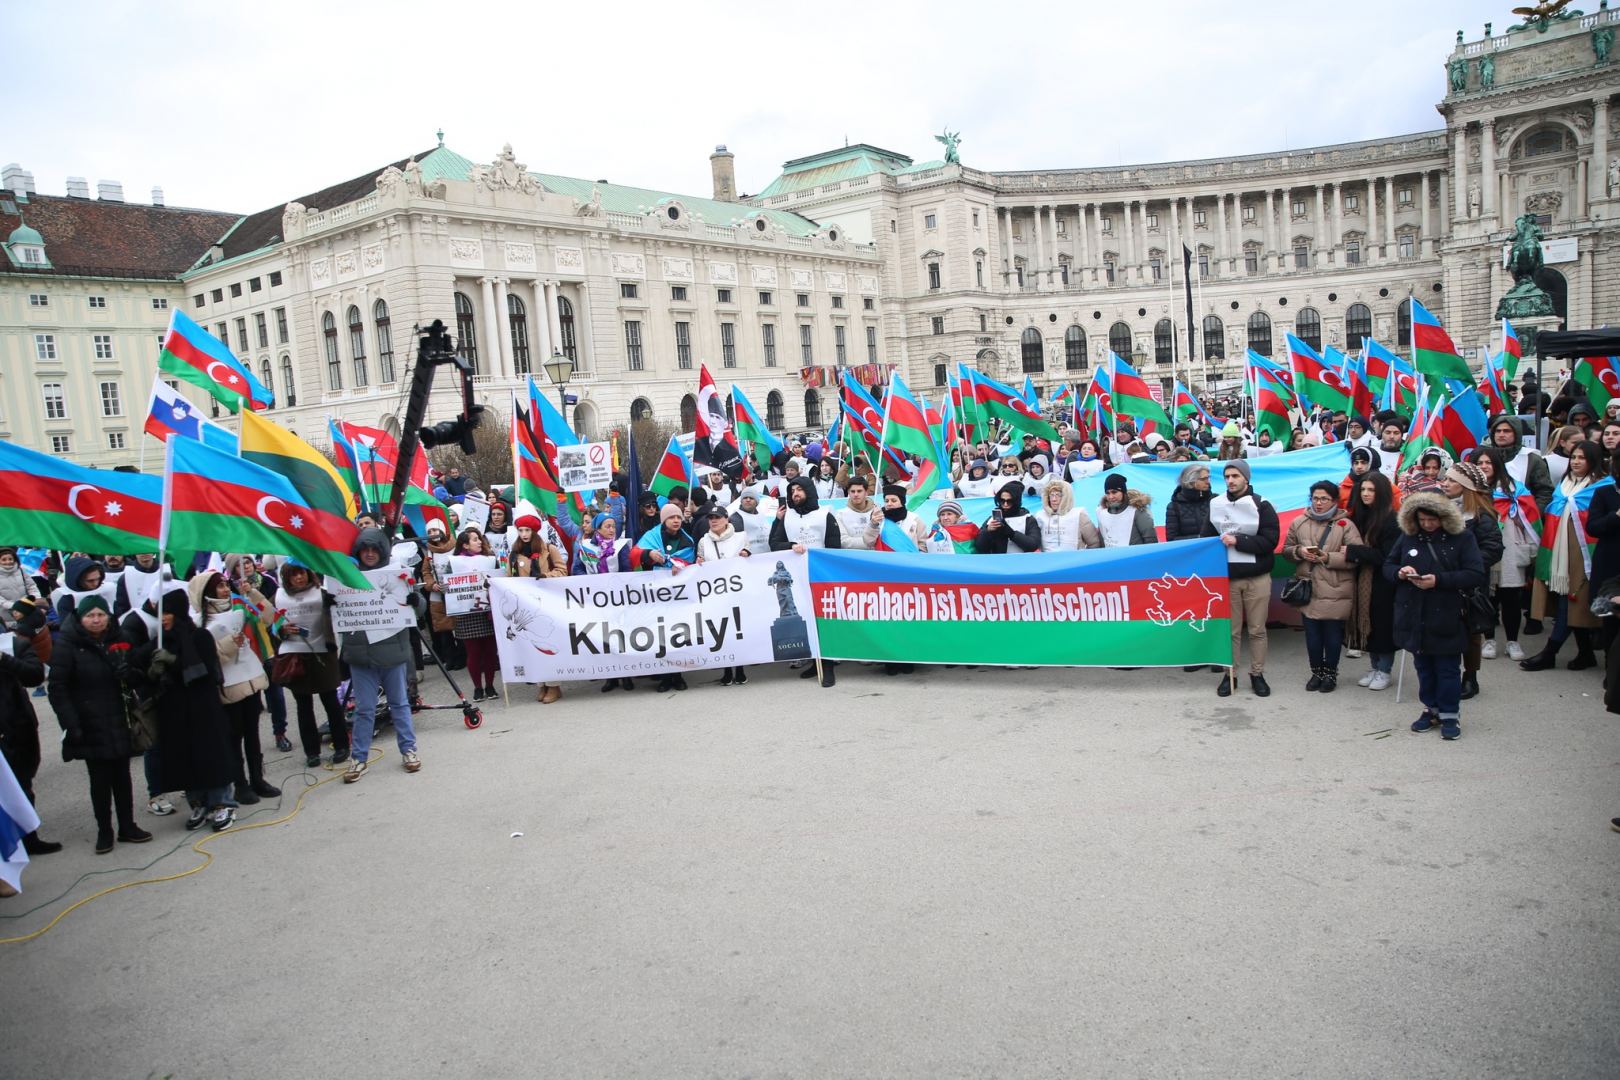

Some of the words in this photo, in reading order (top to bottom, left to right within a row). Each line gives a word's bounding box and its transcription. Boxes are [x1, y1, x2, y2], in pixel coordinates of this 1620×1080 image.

[447, 576, 468, 585] STOPPT
[469, 574, 479, 583] DIE
[565, 583, 689, 610] N'oubliez
[696, 574, 744, 600] pas
[336, 600, 368, 608] Erkenne
[820, 586, 927, 621] #Karabach
[931, 586, 958, 621] ist
[961, 585, 1130, 622] Aserbaidschan!
[336, 608, 383, 617] Völkermord
[338, 618, 380, 627] Chodschali
[382, 617, 394, 625] an!
[568, 606, 744, 659] Khojaly!
[556, 653, 736, 675] www.justiceforkhojaly.org
